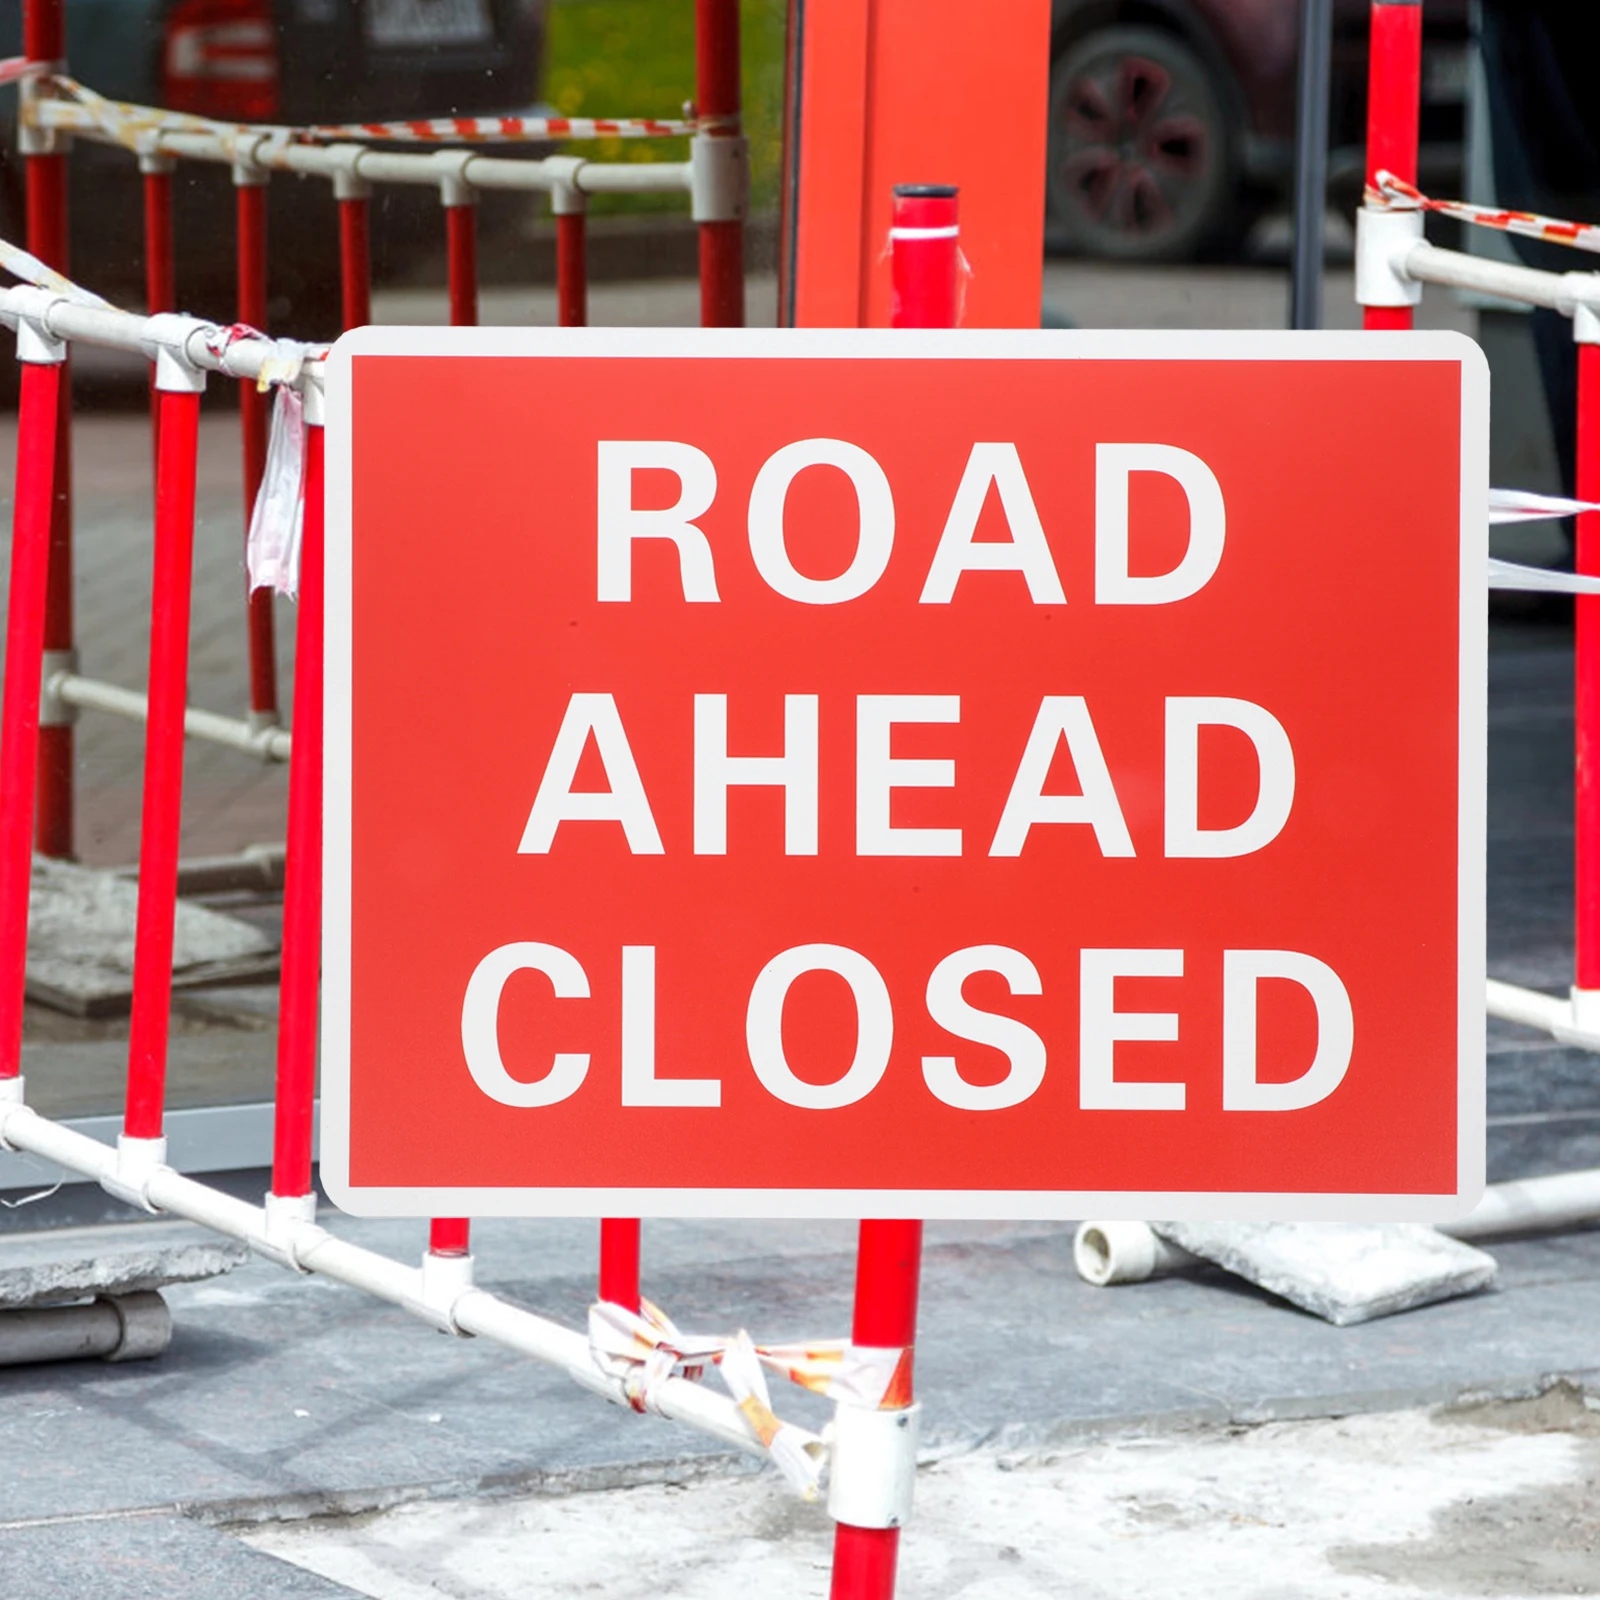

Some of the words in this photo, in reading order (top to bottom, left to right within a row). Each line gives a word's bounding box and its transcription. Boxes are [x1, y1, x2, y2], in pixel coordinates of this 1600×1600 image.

[596, 438, 1226, 605] ROAD
[517, 692, 1296, 859] AHEAD
[461, 941, 1354, 1112] CLOSED
